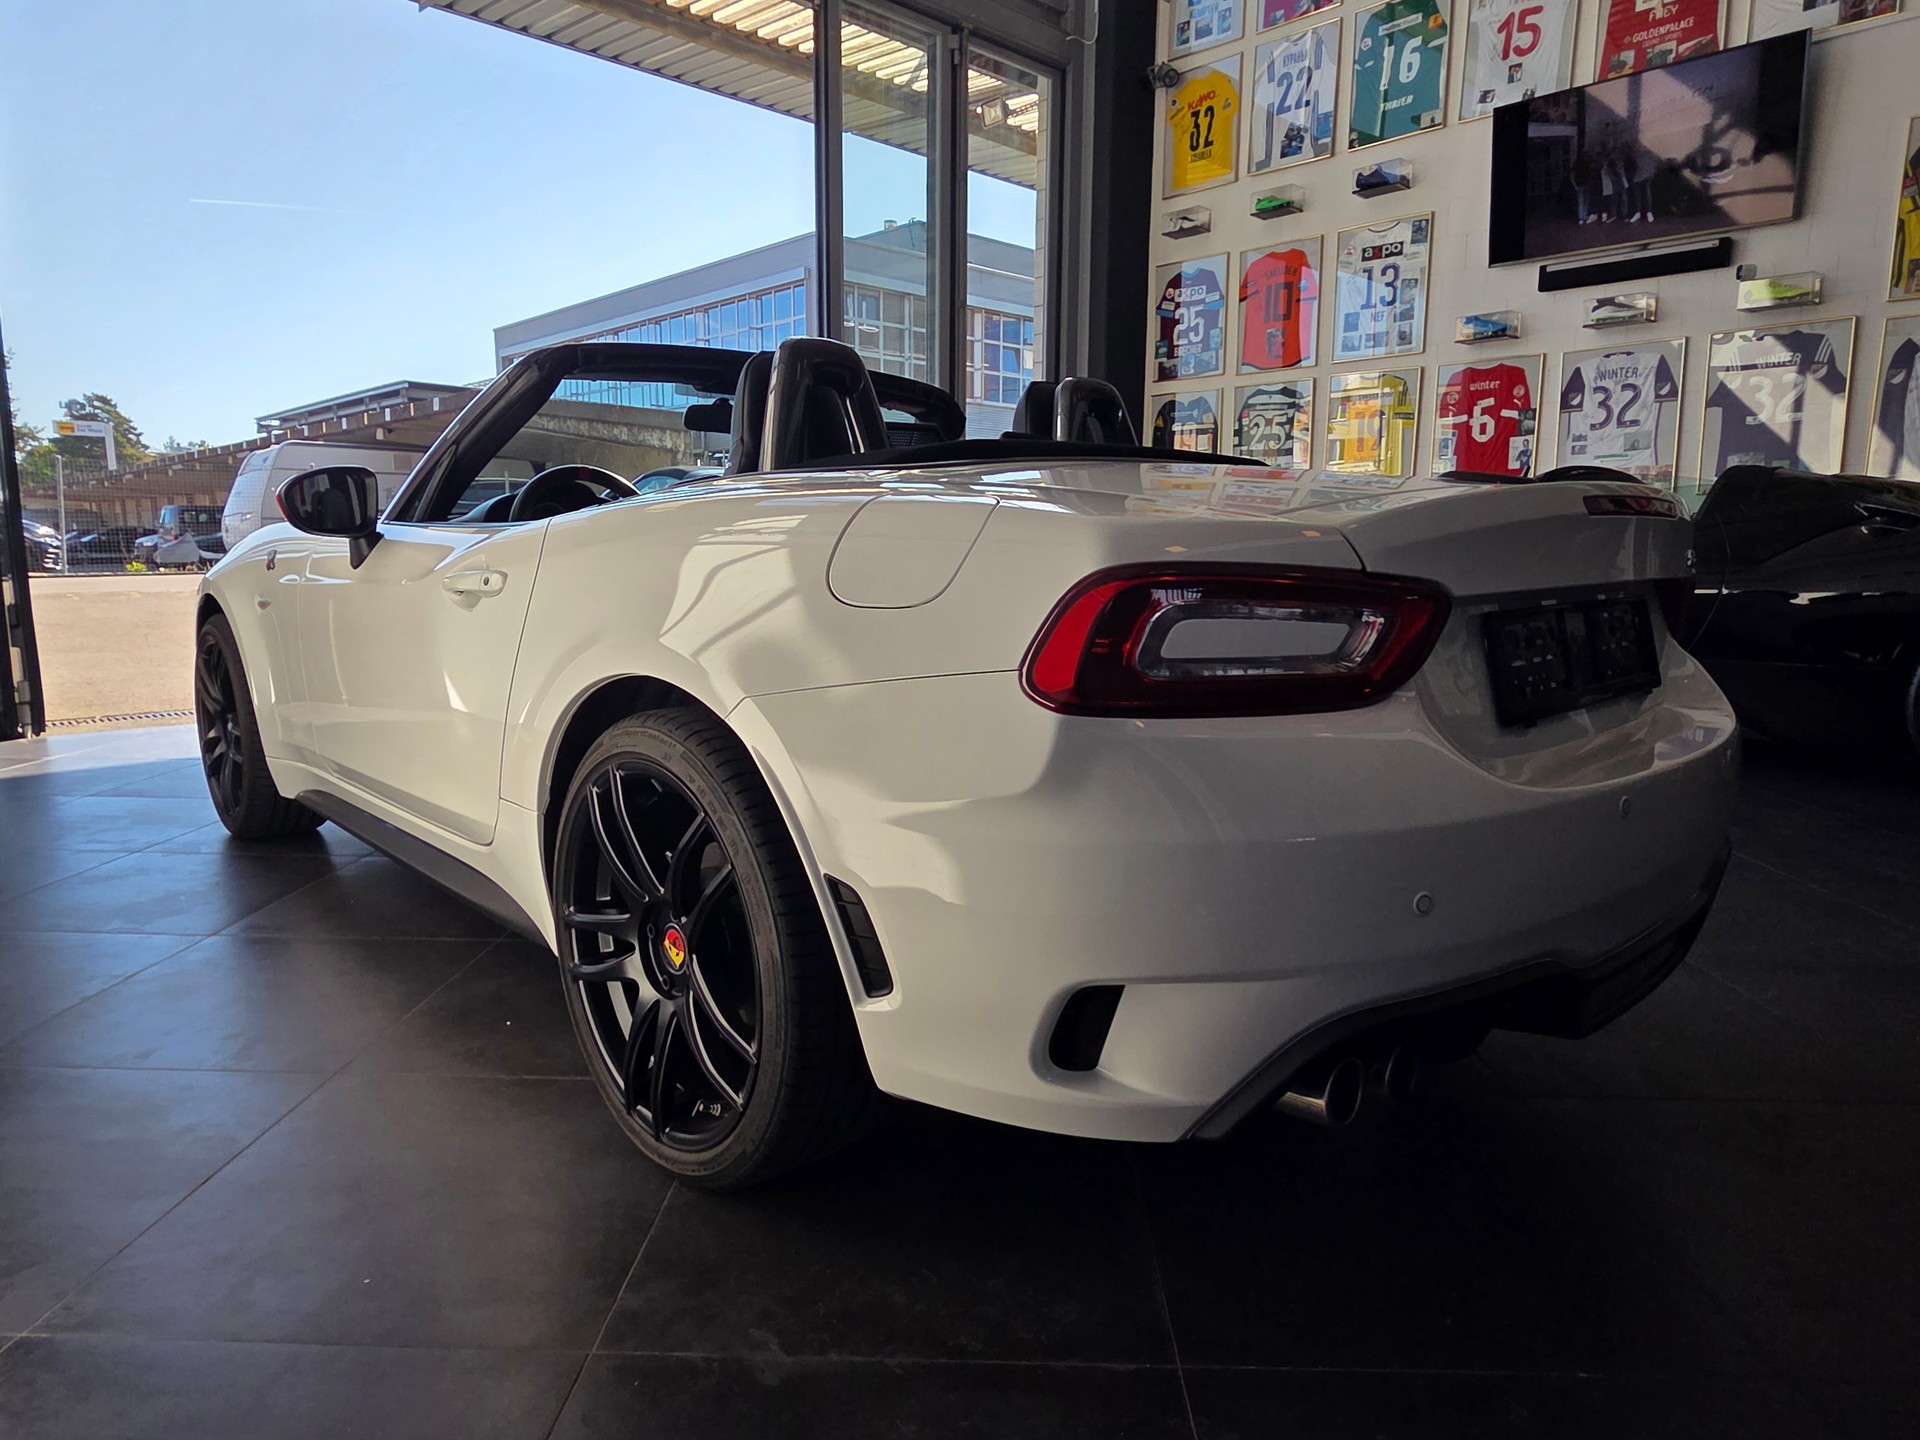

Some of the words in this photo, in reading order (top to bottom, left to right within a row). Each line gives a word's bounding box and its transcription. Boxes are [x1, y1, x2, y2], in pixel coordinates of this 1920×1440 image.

[1496, 4, 1544, 62] 15
[1631, 16, 1695, 43] GOLDENPALACE
[1379, 35, 1424, 91] 16
[1276, 65, 1314, 116] 22
[1189, 105, 1215, 152] 32
[1263, 281, 1294, 324] 10
[1360, 262, 1401, 310] 13
[1173, 304, 1206, 346] 25
[1598, 366, 1639, 381] WINTER
[1757, 352, 1802, 370] WINTER
[1469, 380, 1501, 391] winter
[1590, 383, 1642, 431] 32
[1745, 373, 1808, 425] 32
[1248, 413, 1289, 450] 25
[1469, 397, 1496, 443] 6
